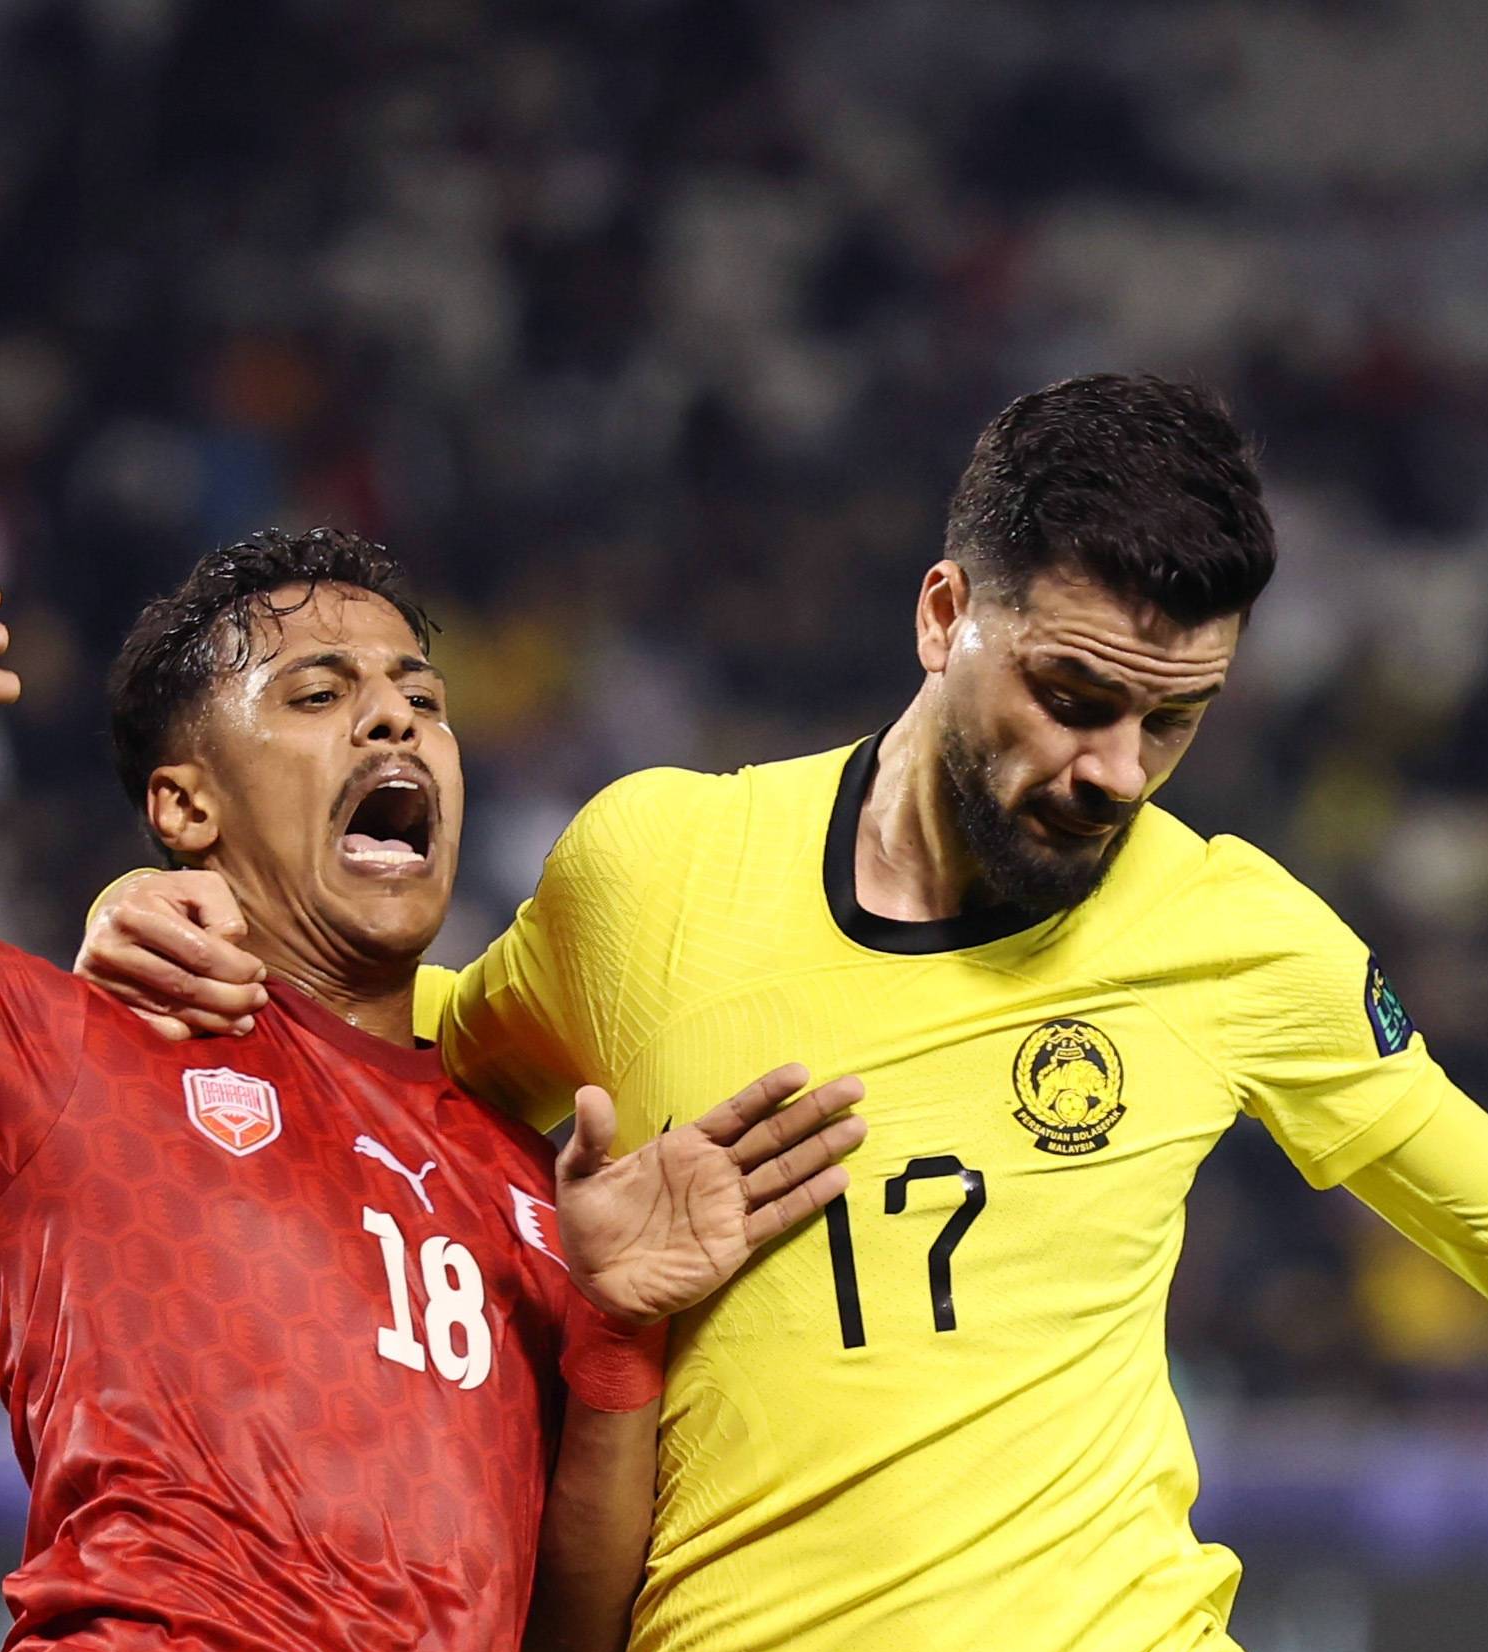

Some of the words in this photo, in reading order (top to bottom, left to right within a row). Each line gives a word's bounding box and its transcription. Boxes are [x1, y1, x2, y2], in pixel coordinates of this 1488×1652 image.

[1017, 1111, 1071, 1142] PERSATUAN
[1072, 1110, 1122, 1142] BOLASEPAK
[1047, 1140, 1096, 1154] MALAYSIA
[362, 1205, 492, 1390] 18
[826, 1154, 986, 1349] 17
